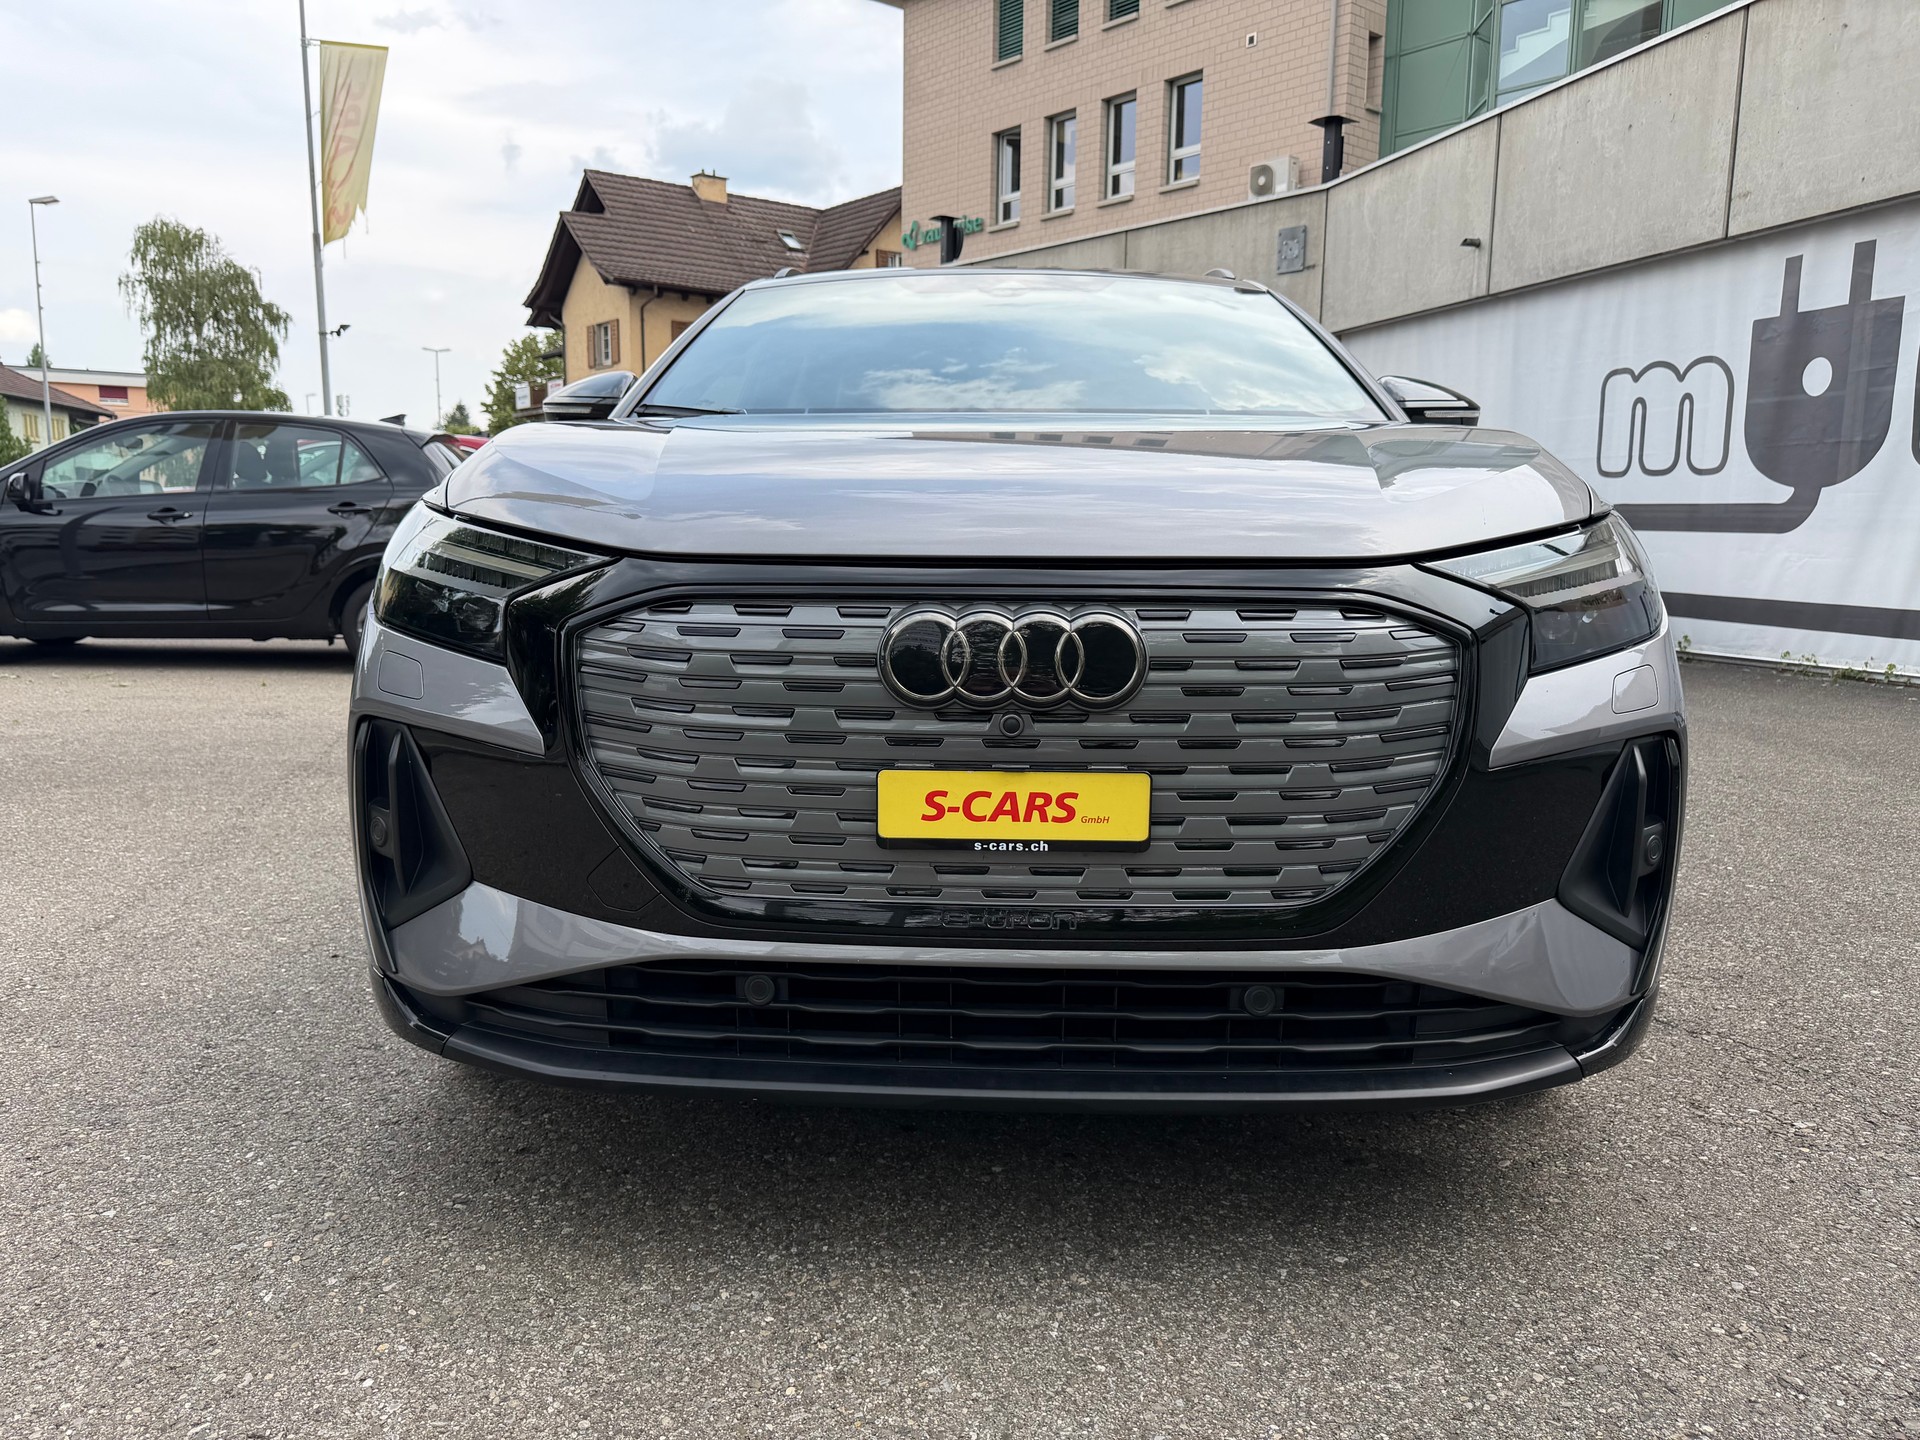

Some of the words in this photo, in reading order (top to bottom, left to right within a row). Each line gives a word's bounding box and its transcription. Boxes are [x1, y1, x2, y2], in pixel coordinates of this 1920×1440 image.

[920, 790, 1079, 824] S-CARS
[1080, 815, 1110, 825] GmbH
[974, 840, 1049, 852] s-cars.ch
